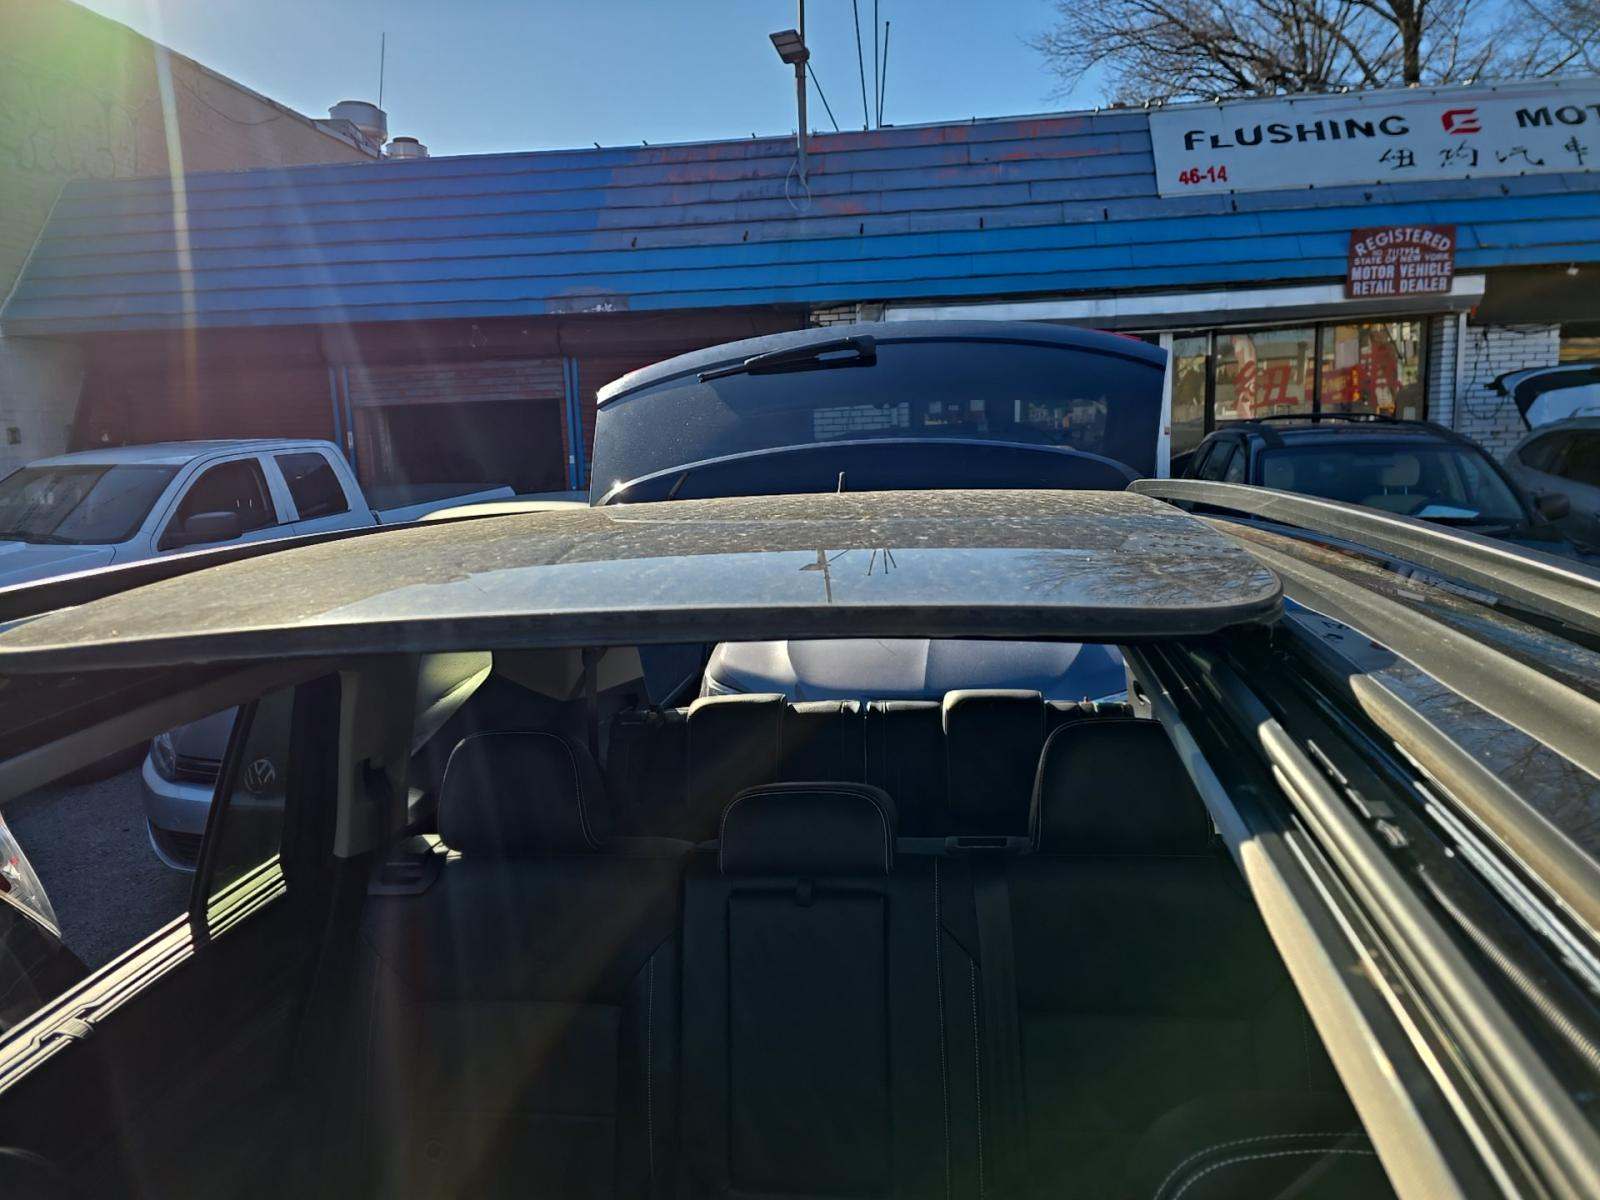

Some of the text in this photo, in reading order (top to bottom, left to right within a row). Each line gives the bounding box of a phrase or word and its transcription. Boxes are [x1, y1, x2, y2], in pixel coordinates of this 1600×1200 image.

[1183, 115, 1409, 151] FLUSHING
[1179, 165, 1228, 185] 46-14
[1355, 228, 1451, 256] REGISTERED
[1351, 261, 1452, 280] MOTOR VEHICLE
[1354, 256, 1382, 266] STATE
[1385, 256, 1397, 265] OF
[1353, 277, 1447, 296] RETAIL DEALER
